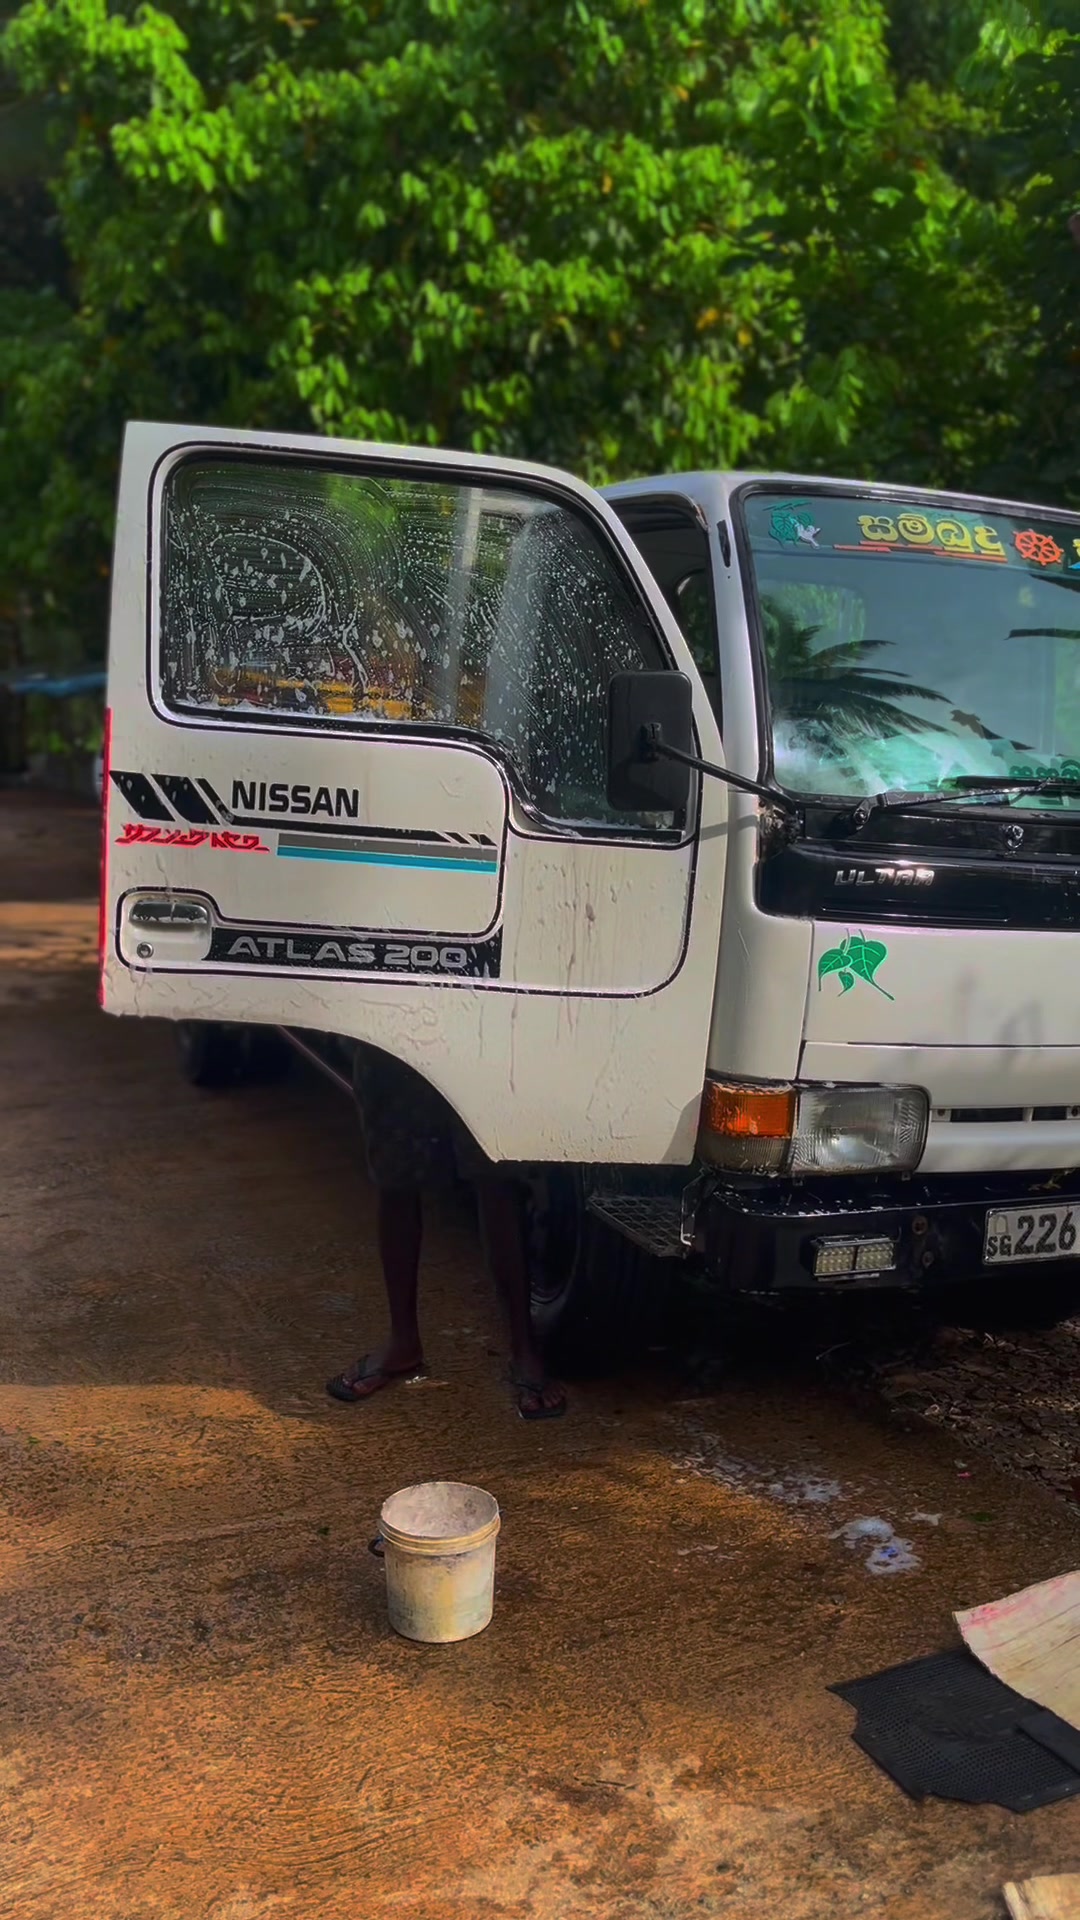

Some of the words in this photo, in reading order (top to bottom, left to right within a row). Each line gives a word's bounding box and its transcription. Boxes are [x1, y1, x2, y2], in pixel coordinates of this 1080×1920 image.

[231, 780, 359, 818] NISSAN
[228, 936, 375, 964] ATLAS
[384, 944, 468, 968] 200
[987, 1235, 1012, 1257] SG
[1014, 1212, 1077, 1255] 226
